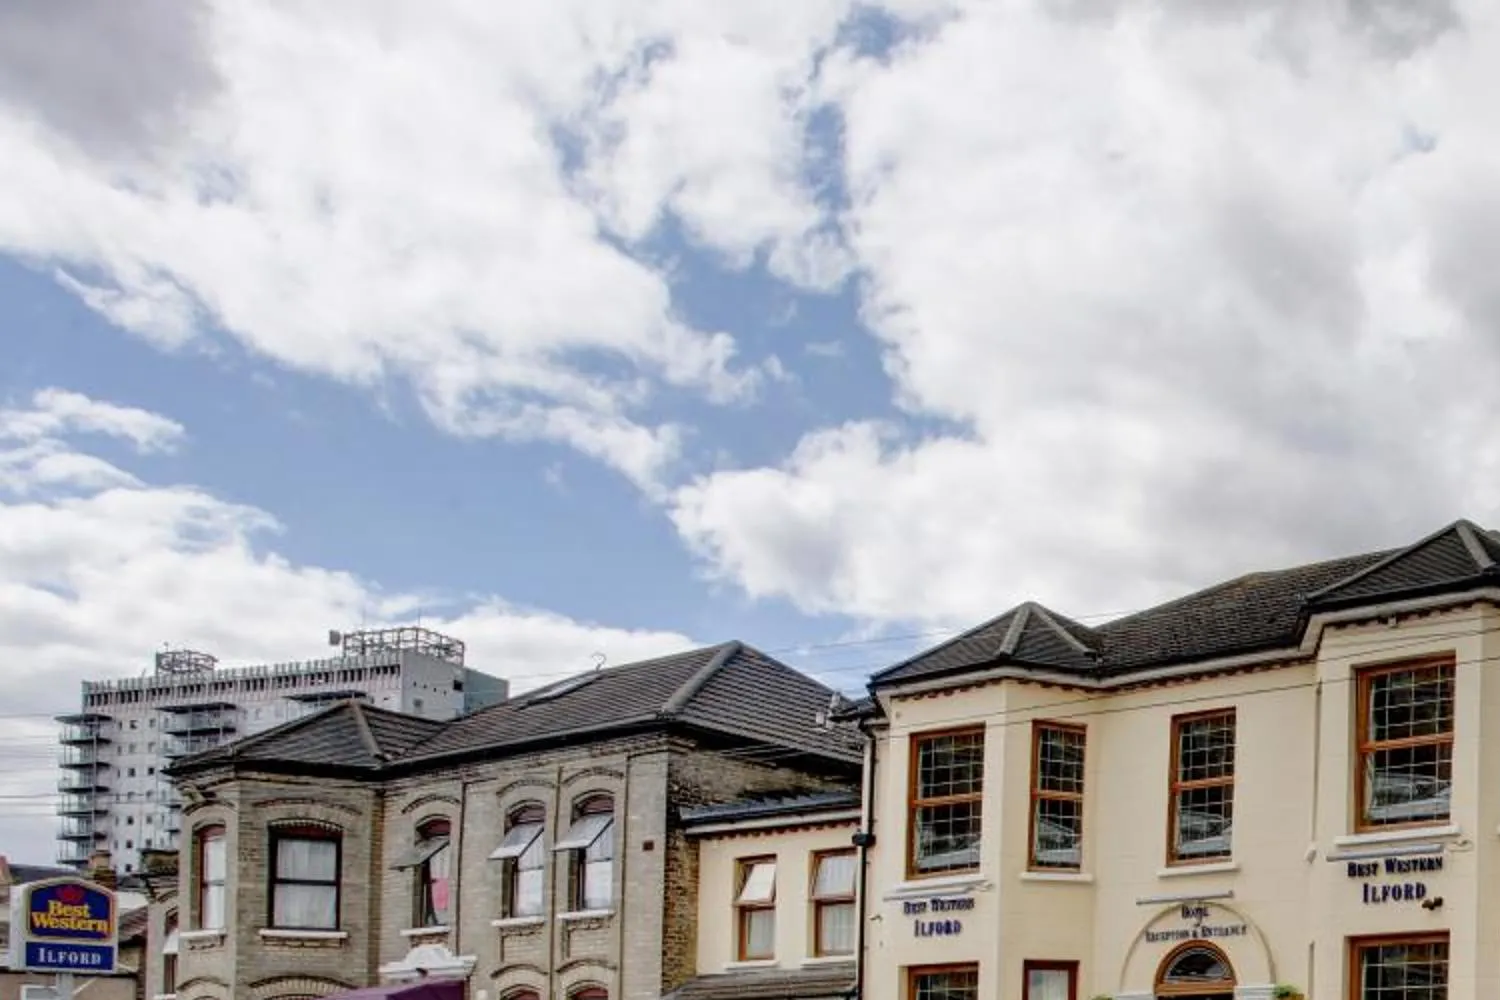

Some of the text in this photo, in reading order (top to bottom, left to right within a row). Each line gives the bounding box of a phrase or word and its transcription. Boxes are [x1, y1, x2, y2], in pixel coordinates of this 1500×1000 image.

[1363, 882, 1426, 903] ILFORD
[48, 900, 91, 918] Best
[31, 911, 110, 932] Western
[38, 947, 101, 965] ILFORD
